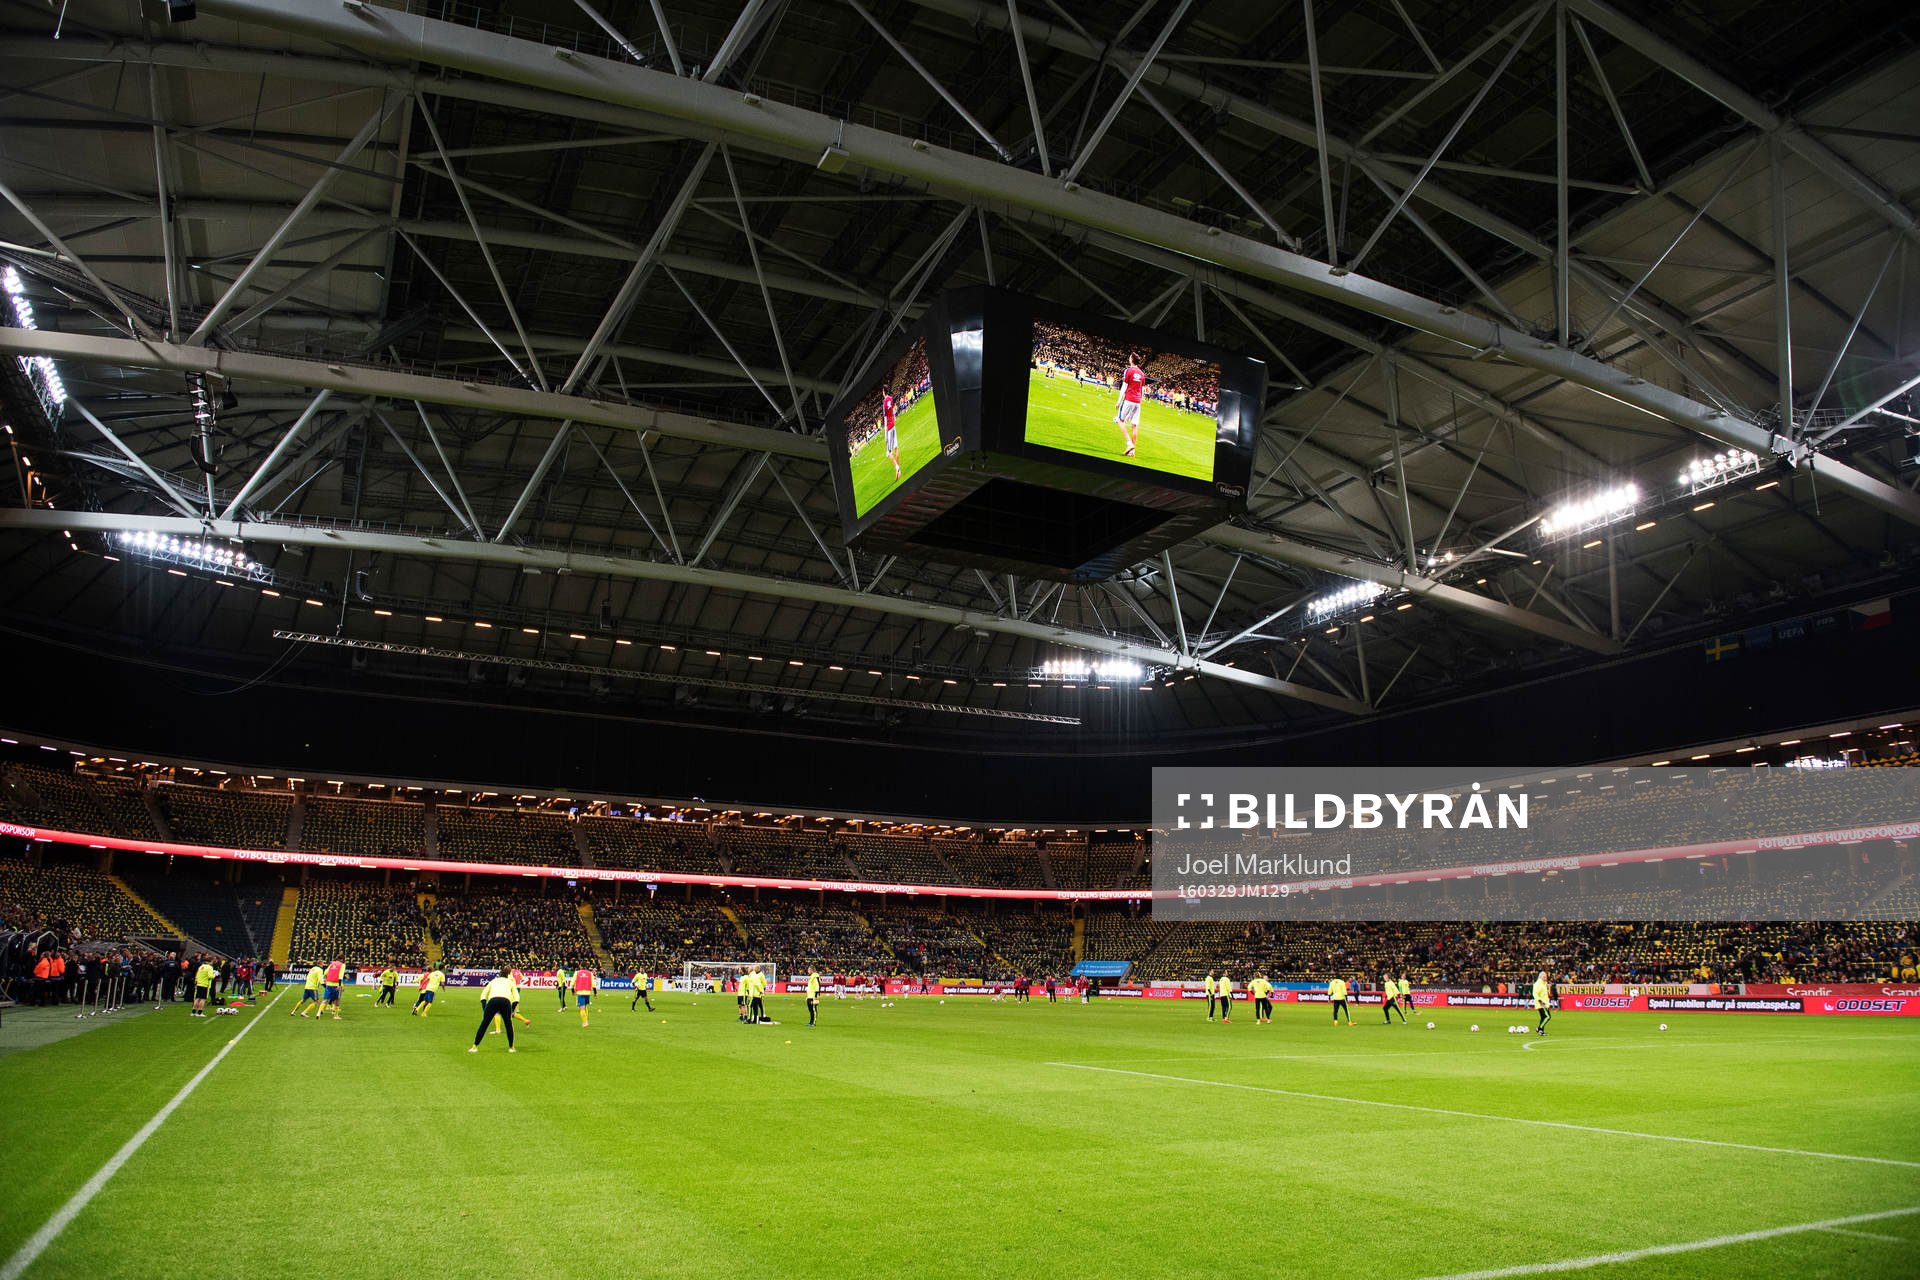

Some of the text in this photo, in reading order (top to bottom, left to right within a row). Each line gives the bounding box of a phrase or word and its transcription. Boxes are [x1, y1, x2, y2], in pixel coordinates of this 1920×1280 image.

[1779, 627, 1805, 640] UEFA
[0, 823, 35, 837] DSPONSOR
[1758, 823, 1920, 849] FOTBOLLENS HUVUDSPONSOR
[233, 850, 362, 865] FOTBOLLENS HUVUDSPONSOR
[1473, 858, 1579, 875] FOTBOLLENS HUVUDSPONSOR
[551, 868, 661, 880] FOTBOLLENS HUVUDSPONSOR
[821, 881, 861, 890] FOTBOLLENS
[675, 980, 710, 989] weber
[1648, 985, 1689, 995] SVERIGE
[1787, 987, 1833, 996] Scandic
[1881, 987, 1920, 996] Scand
[1583, 997, 1633, 1008] ODDSET
[1649, 999, 1670, 1009] Spela
[1675, 999, 1705, 1008] mobilen
[1706, 999, 1724, 1009] eller
[1724, 999, 1735, 1010] på
[1736, 1000, 1801, 1011] svenskaspel.se
[1836, 999, 1907, 1012] ODDSET
